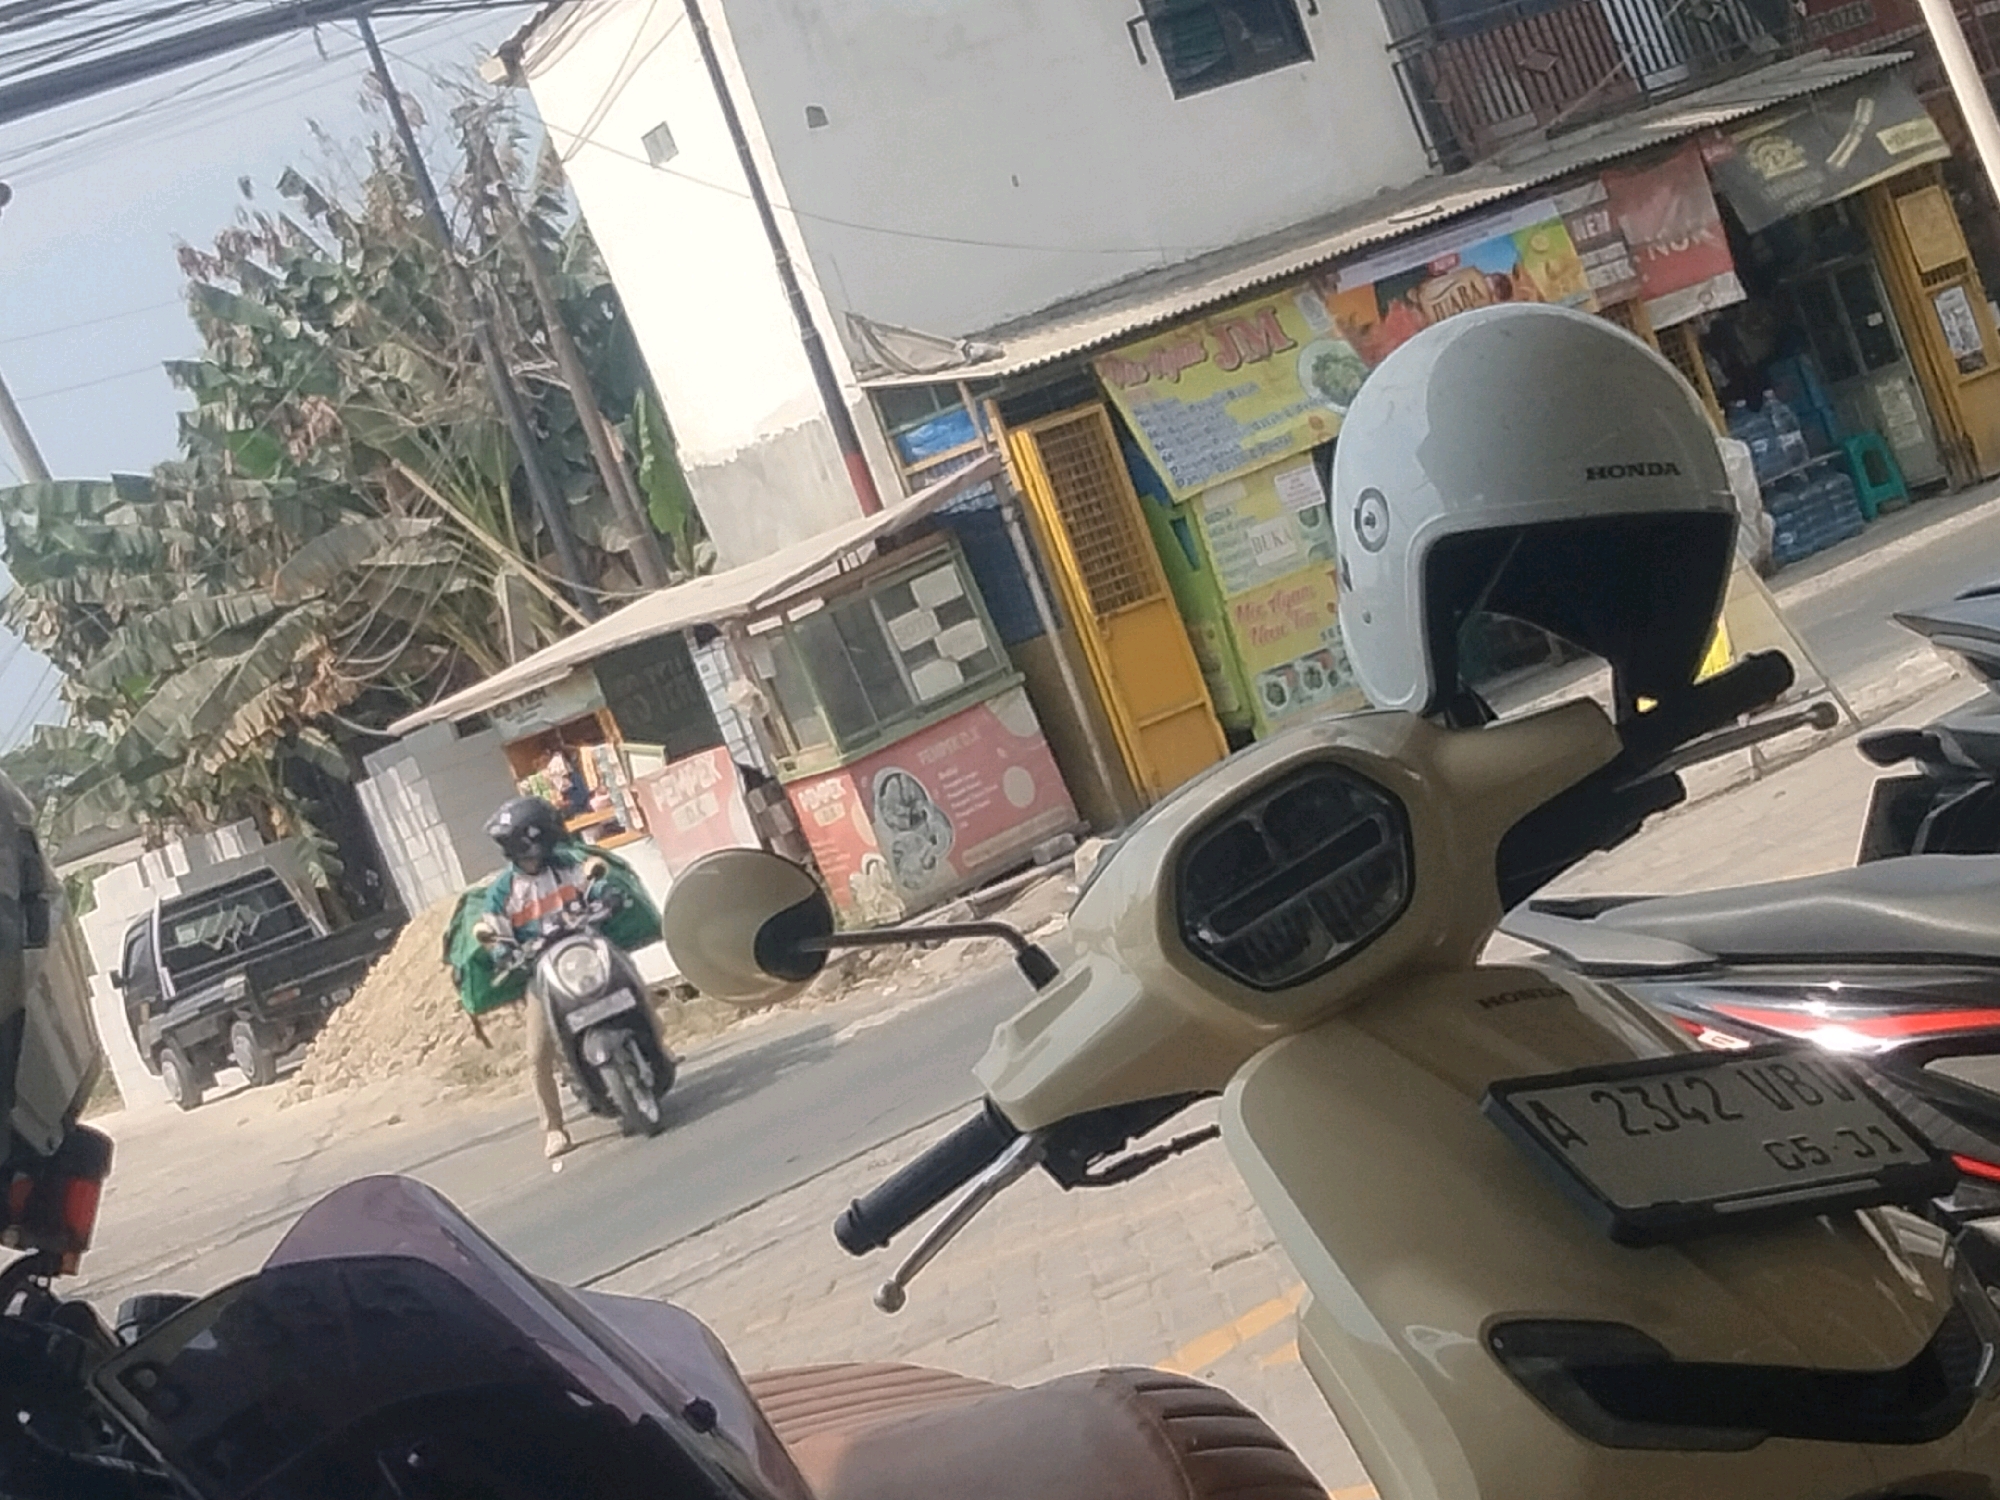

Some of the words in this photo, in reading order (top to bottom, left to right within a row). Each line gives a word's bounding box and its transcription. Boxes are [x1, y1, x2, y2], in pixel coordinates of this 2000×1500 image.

[1212, 305, 1299, 372] JM
[1585, 462, 1682, 480] HONDA
[1526, 1100, 1589, 1149] A
[1589, 1075, 1745, 1137] 2342
